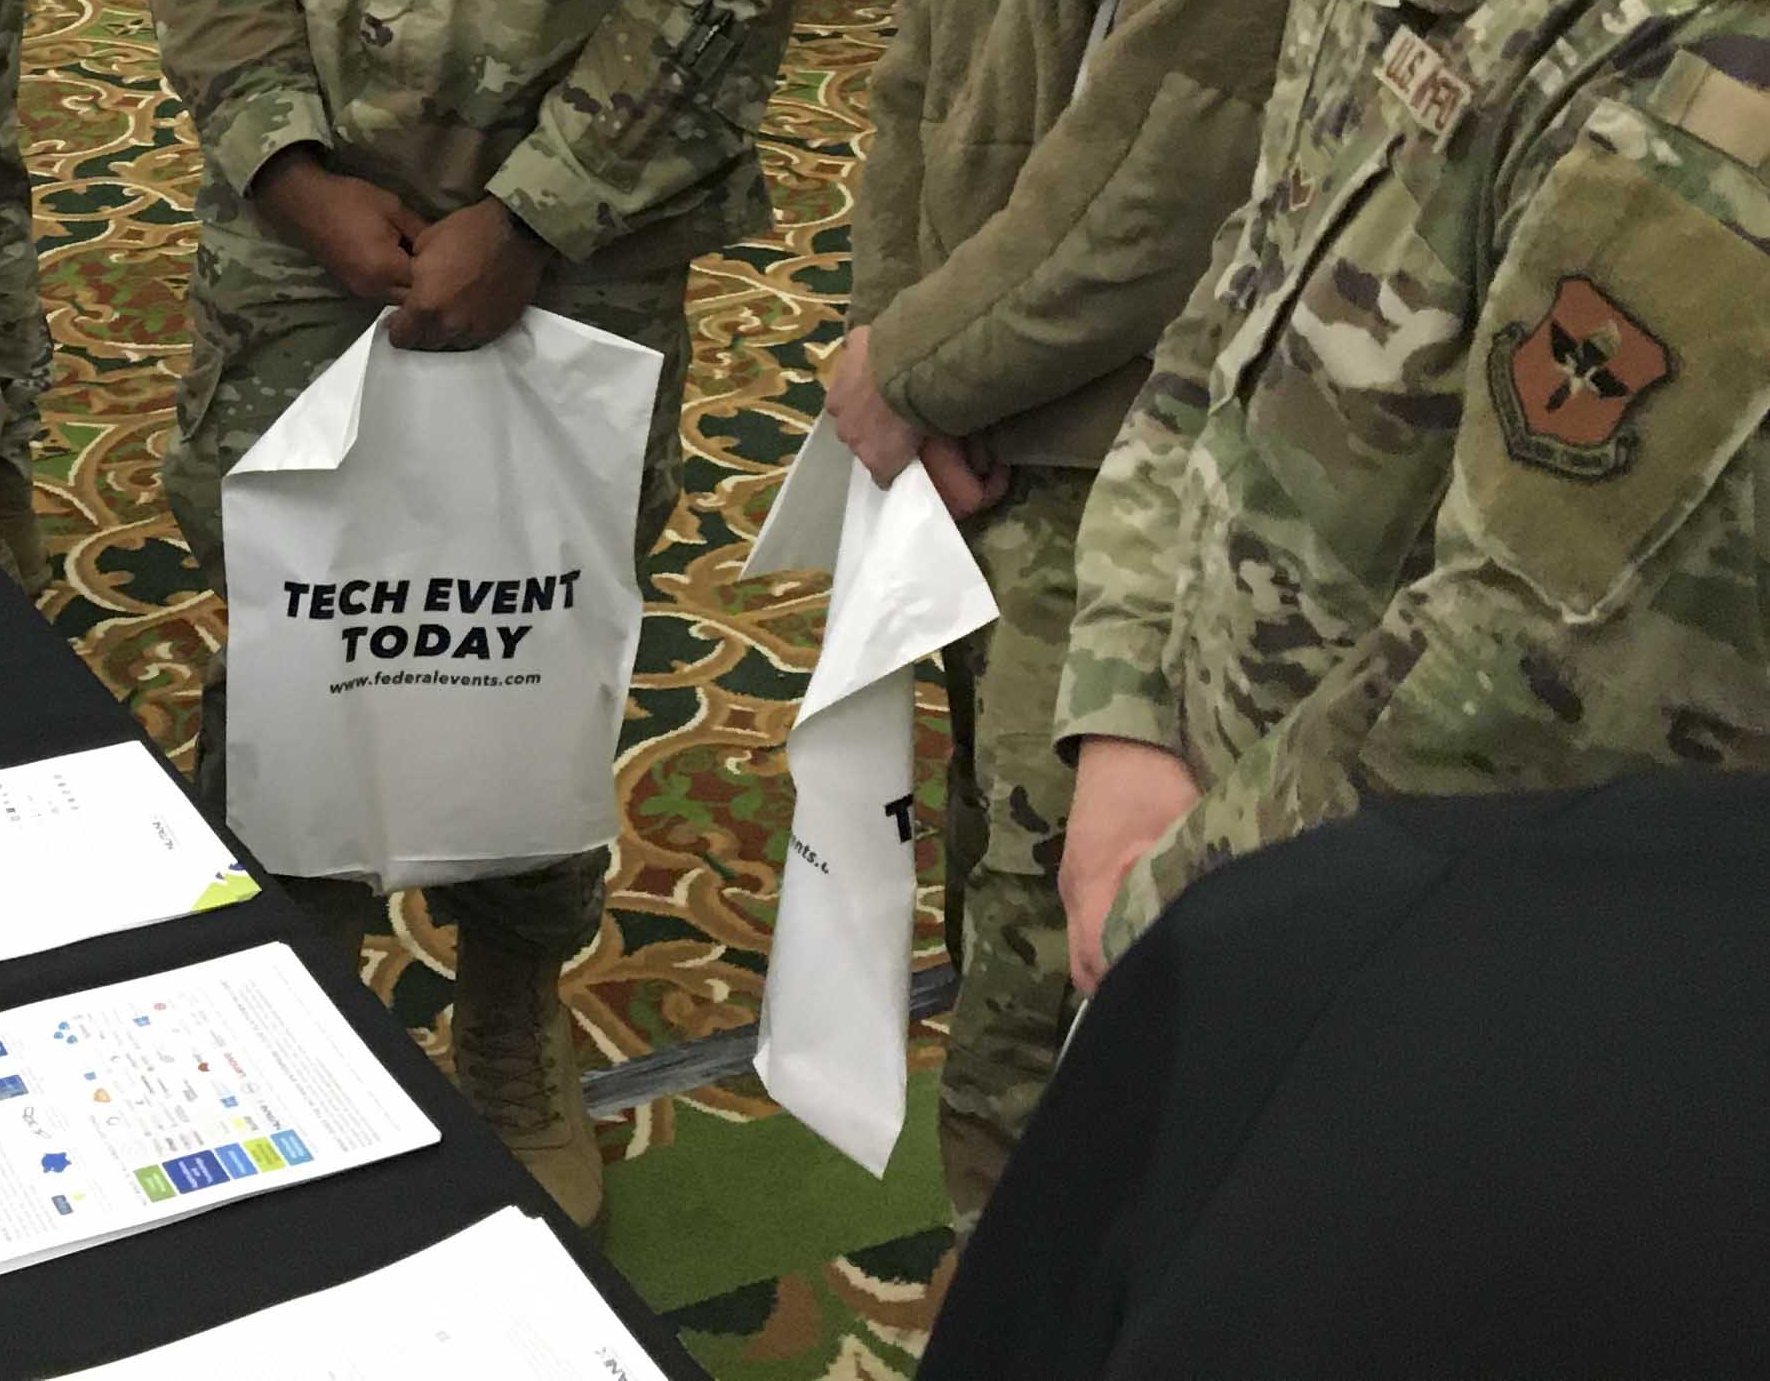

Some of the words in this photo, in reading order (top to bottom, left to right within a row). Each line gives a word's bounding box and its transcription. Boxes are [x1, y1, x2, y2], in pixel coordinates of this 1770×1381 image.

[283, 579, 411, 620] TECH
[423, 569, 582, 615] EVENT
[340, 623, 533, 663] TODAY
[330, 670, 542, 695] www.federalevents.com
